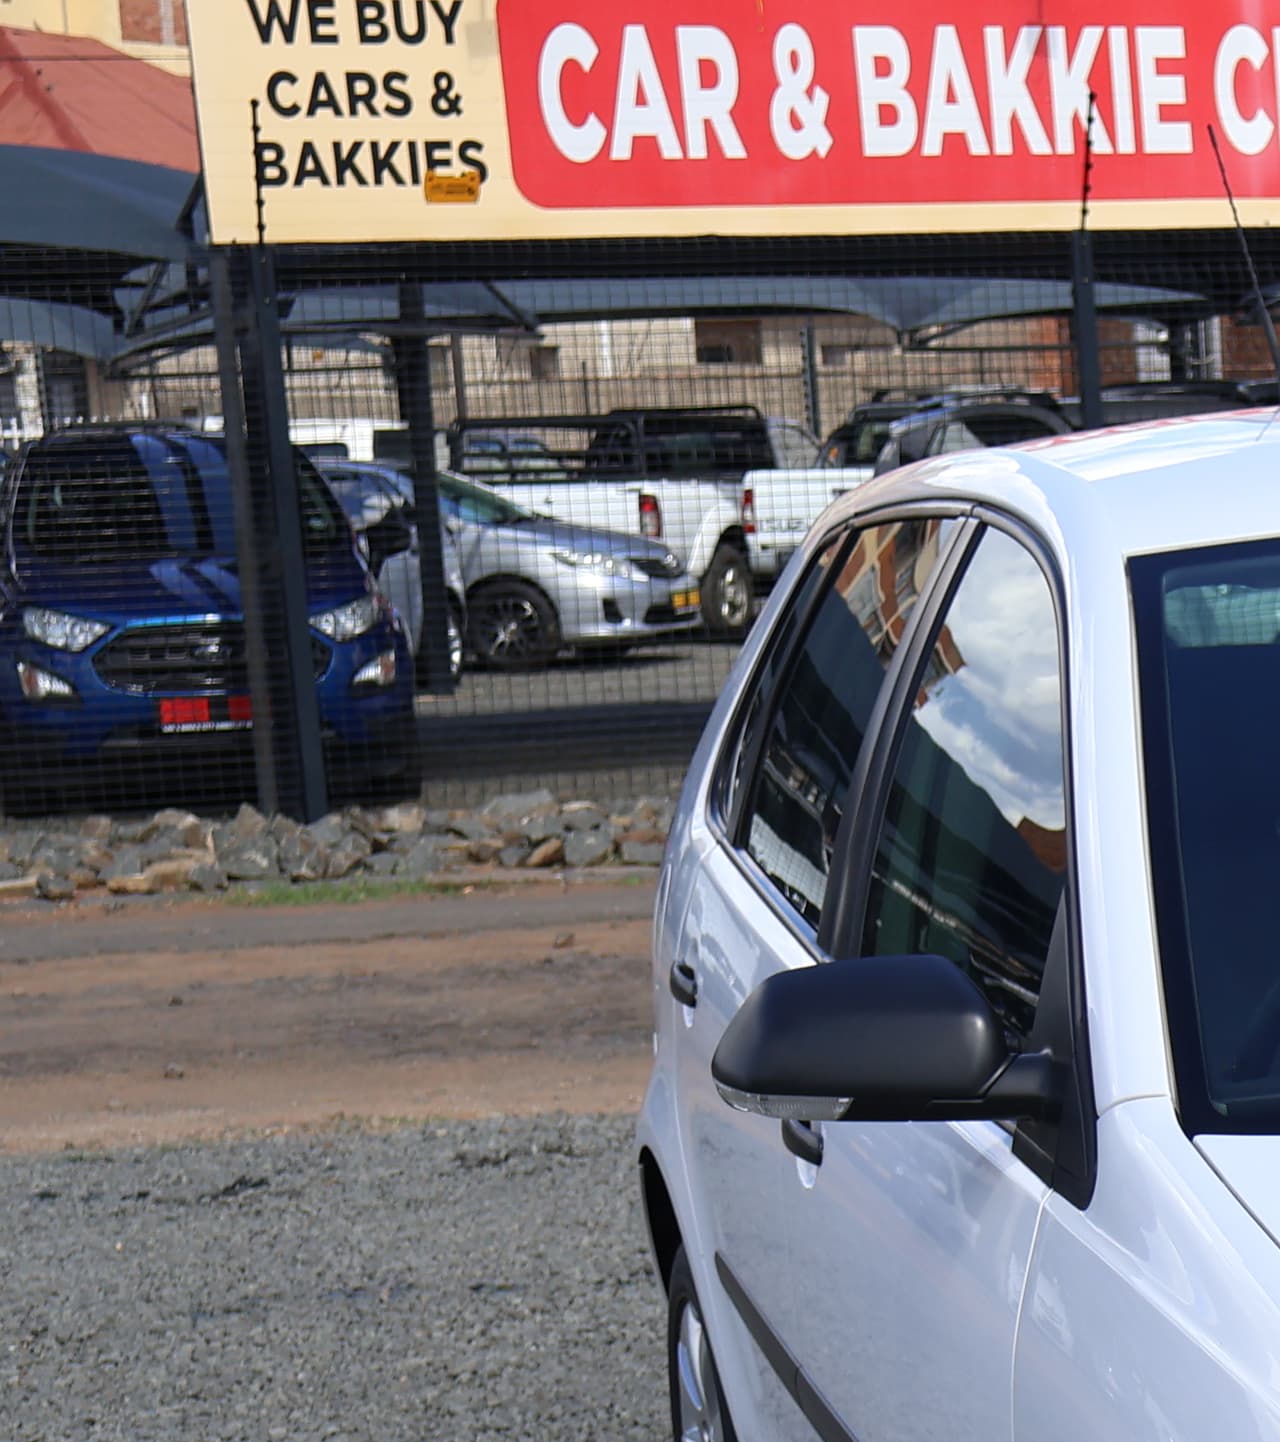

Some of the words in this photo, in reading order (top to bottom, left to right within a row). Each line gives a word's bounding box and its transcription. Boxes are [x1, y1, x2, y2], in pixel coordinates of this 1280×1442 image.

[246, 0, 339, 44] WE
[355, 0, 463, 45] BUY
[266, 71, 412, 118] CARS
[430, 71, 463, 117] &
[538, 22, 748, 163] CAR
[770, 23, 834, 160] &
[852, 25, 1194, 157] BAKKIE
[257, 140, 488, 187] BAKKIES
